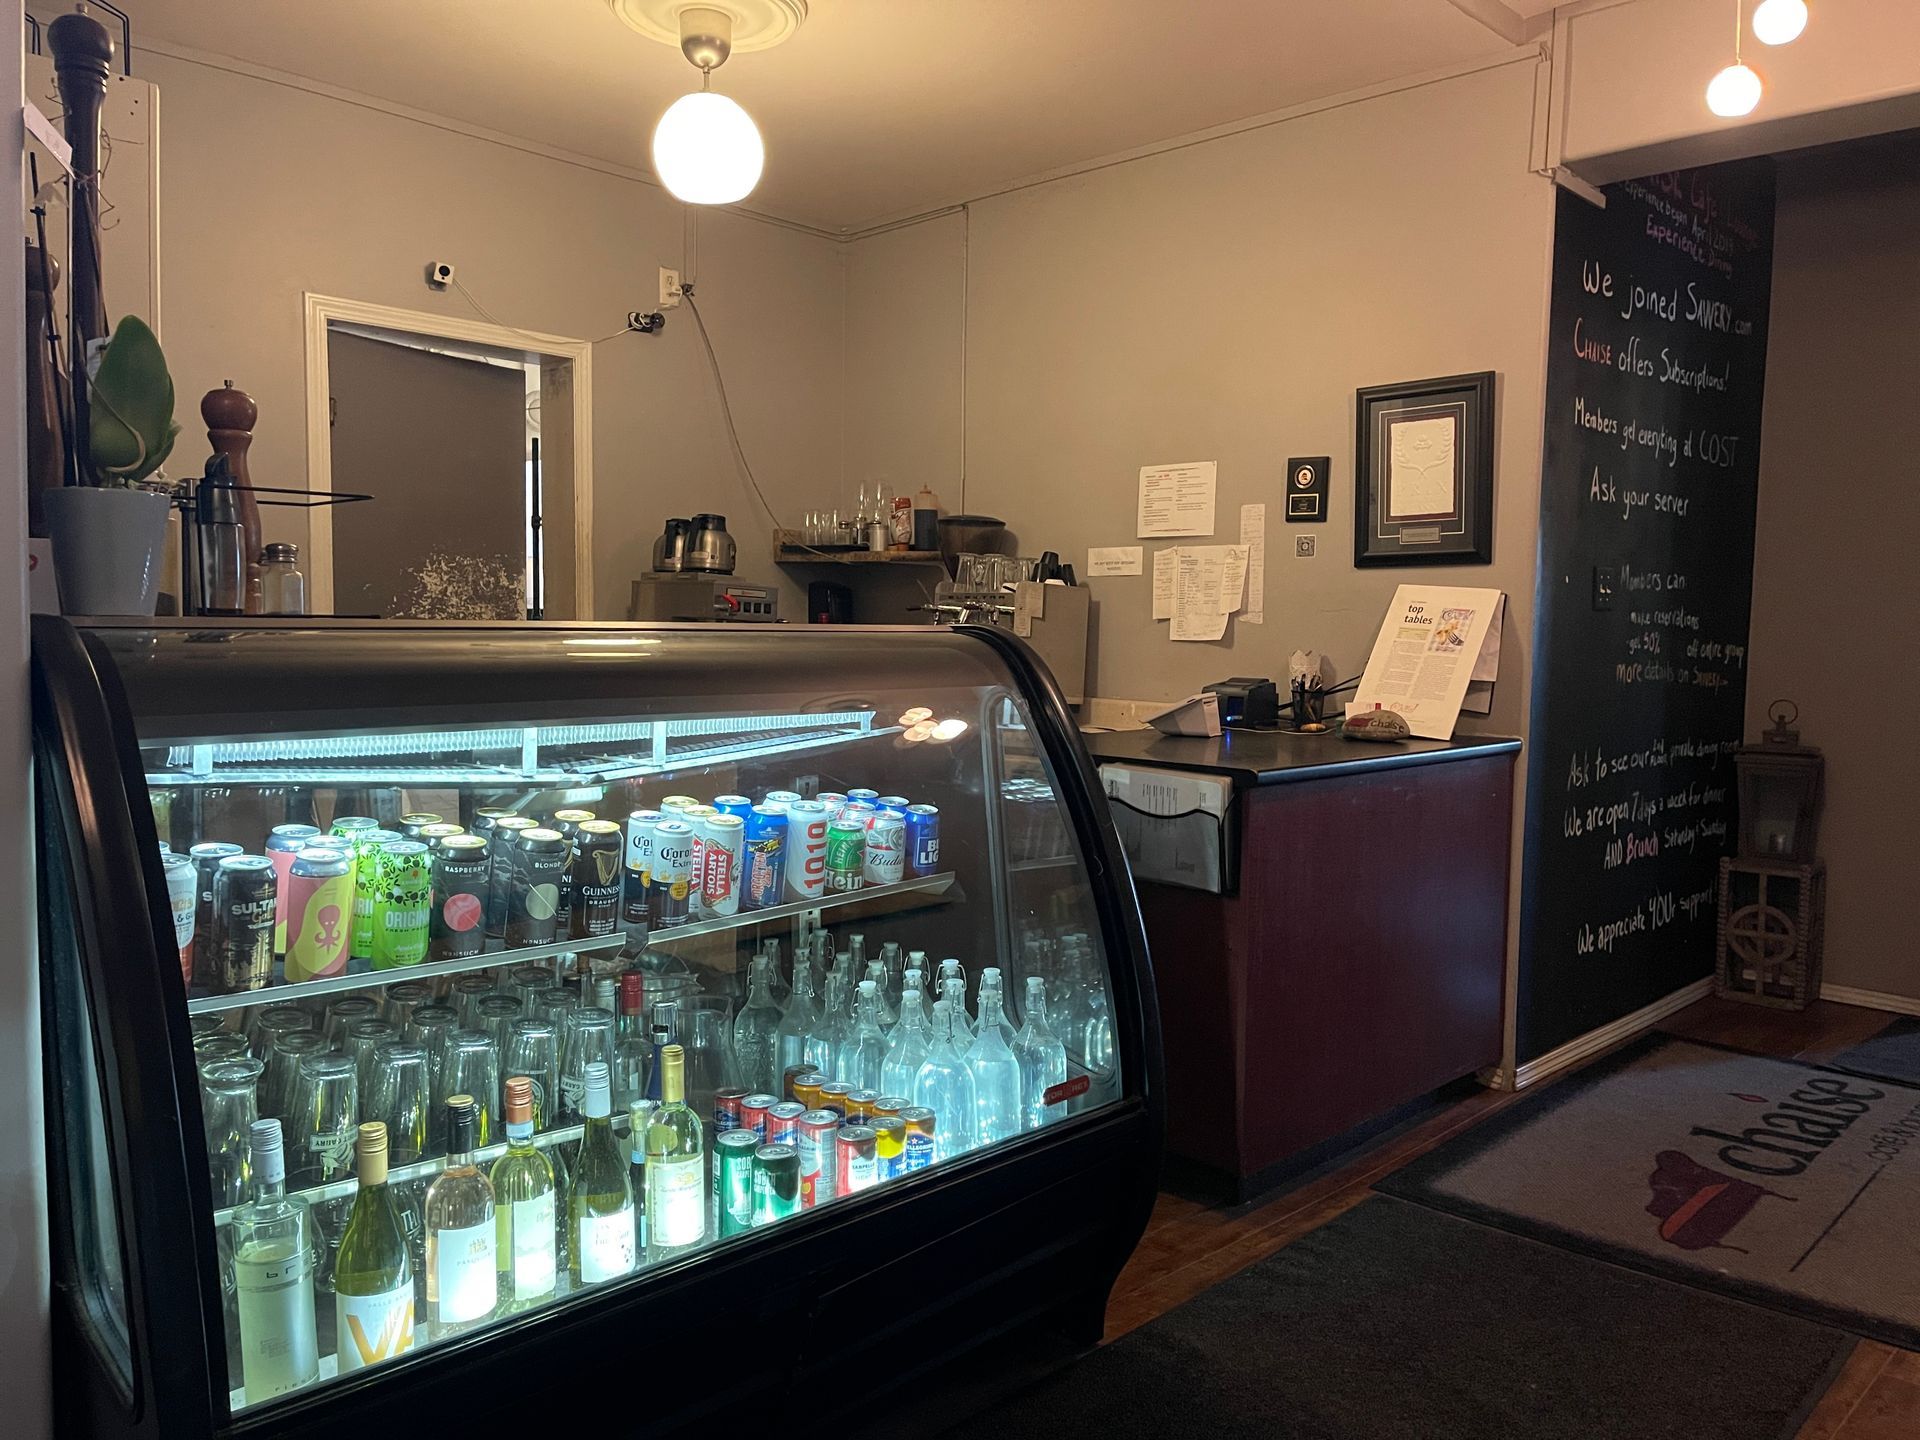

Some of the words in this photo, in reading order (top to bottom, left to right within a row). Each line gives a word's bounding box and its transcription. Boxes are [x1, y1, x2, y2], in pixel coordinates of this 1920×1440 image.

[1645, 213, 1706, 263] Experience
[1582, 259, 1614, 297] We
[1621, 275, 1677, 322] joined
[1618, 335, 1655, 377] offers
[1659, 347, 1730, 395] Subscriptions!
[1574, 396, 1618, 435] Members
[1621, 418, 1636, 451] get
[1683, 430, 1693, 458] at
[1699, 430, 1740, 468] COST
[1590, 465, 1617, 504] Ask
[1623, 489, 1651, 521] your
[1654, 491, 1689, 518] server
[1666, 572, 1687, 590] can
[1404, 613, 1433, 626] tables
[1408, 604, 1424, 615] top
[1643, 631, 1661, 656] 50%
[1616, 662, 1643, 684] more
[1370, 717, 1406, 734] chaise
[1567, 750, 1590, 791] Ask
[1595, 747, 1608, 782] to
[1630, 748, 1650, 770] our
[1563, 807, 1582, 839] We
[1586, 802, 1604, 830] are
[1606, 801, 1629, 835] open
[444, 865, 486, 874] RASPBERRY
[691, 843, 704, 885] STELLA
[1603, 840, 1623, 870] AND
[1626, 832, 1660, 865] Brunch
[706, 852, 718, 895] ARTOIS
[715, 854, 728, 896] STELLA
[1577, 922, 1595, 956] We
[1597, 905, 1647, 955] appreciate
[1689, 1077, 1886, 1177] chaise
